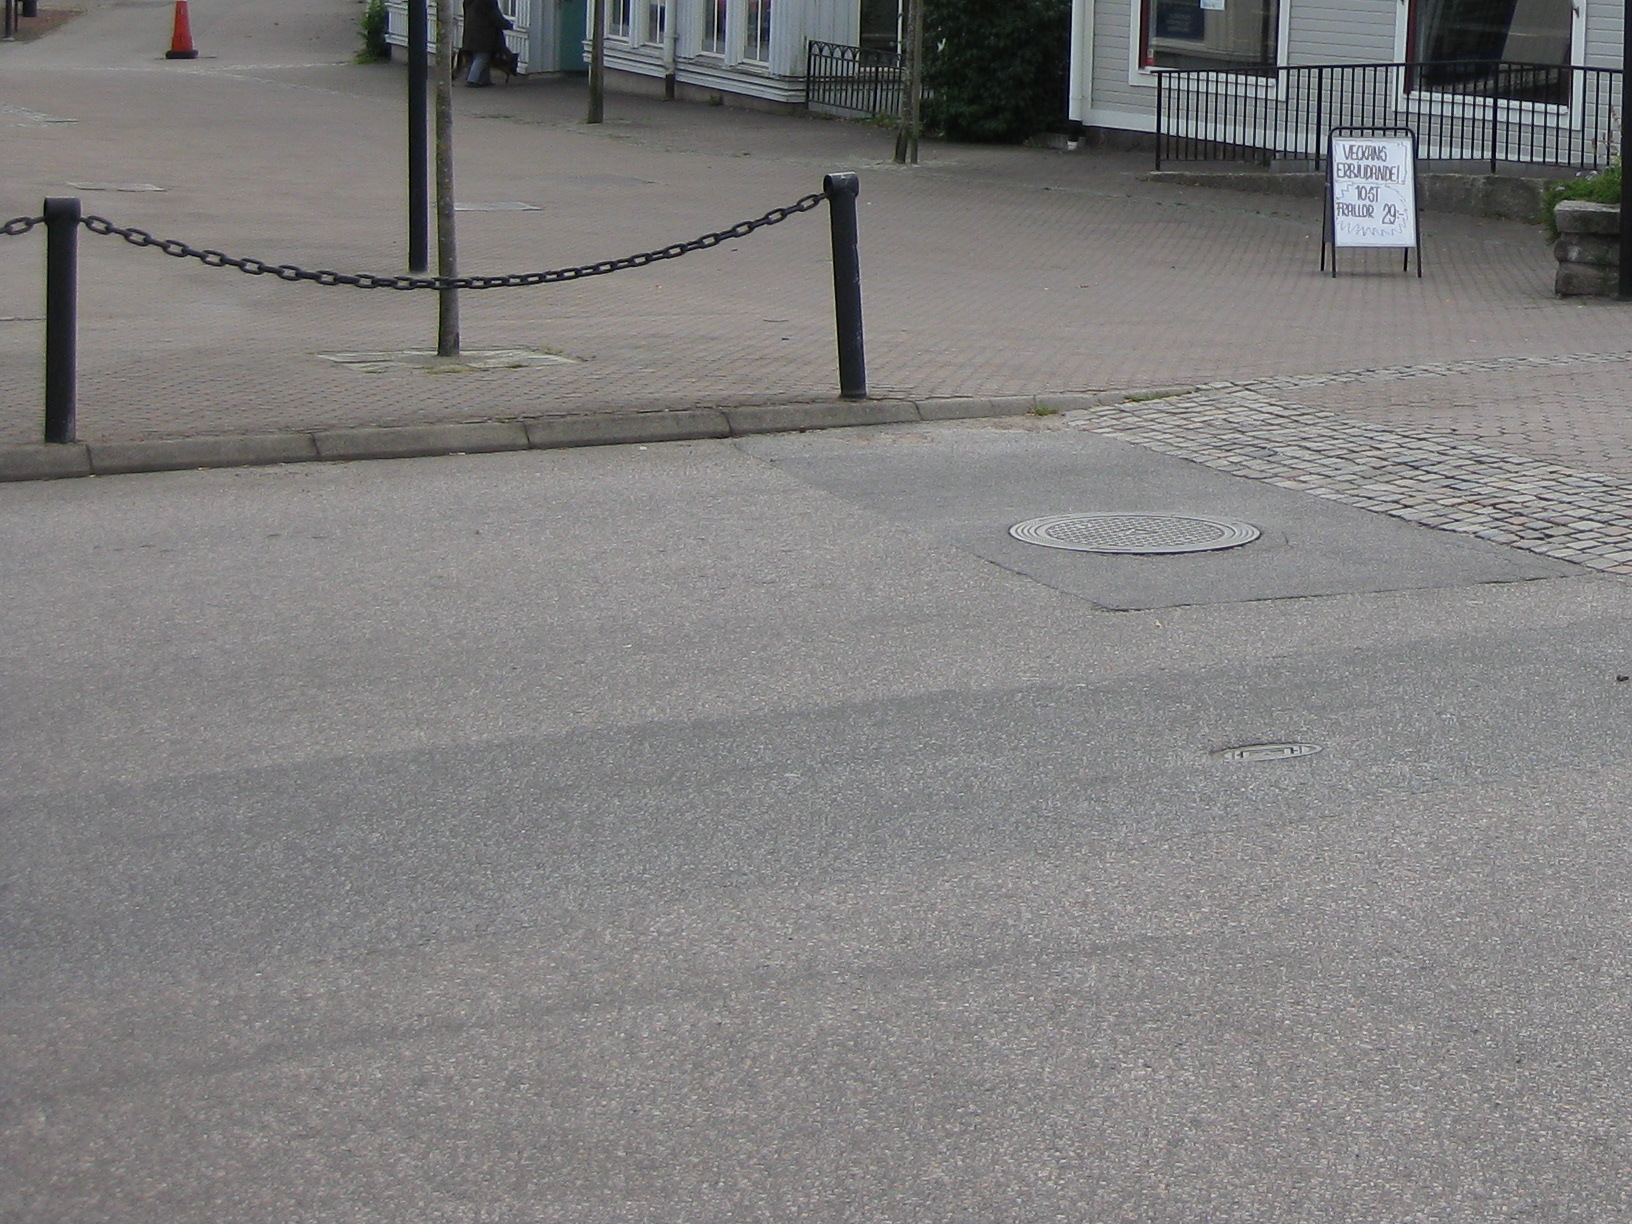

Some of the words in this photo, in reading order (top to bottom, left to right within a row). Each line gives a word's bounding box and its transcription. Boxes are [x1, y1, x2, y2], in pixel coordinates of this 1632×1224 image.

[1342, 144, 1388, 163] VECKANS
[1336, 161, 1401, 184] ERBJUDANDE!
[1336, 202, 1375, 219] FRALLOR
